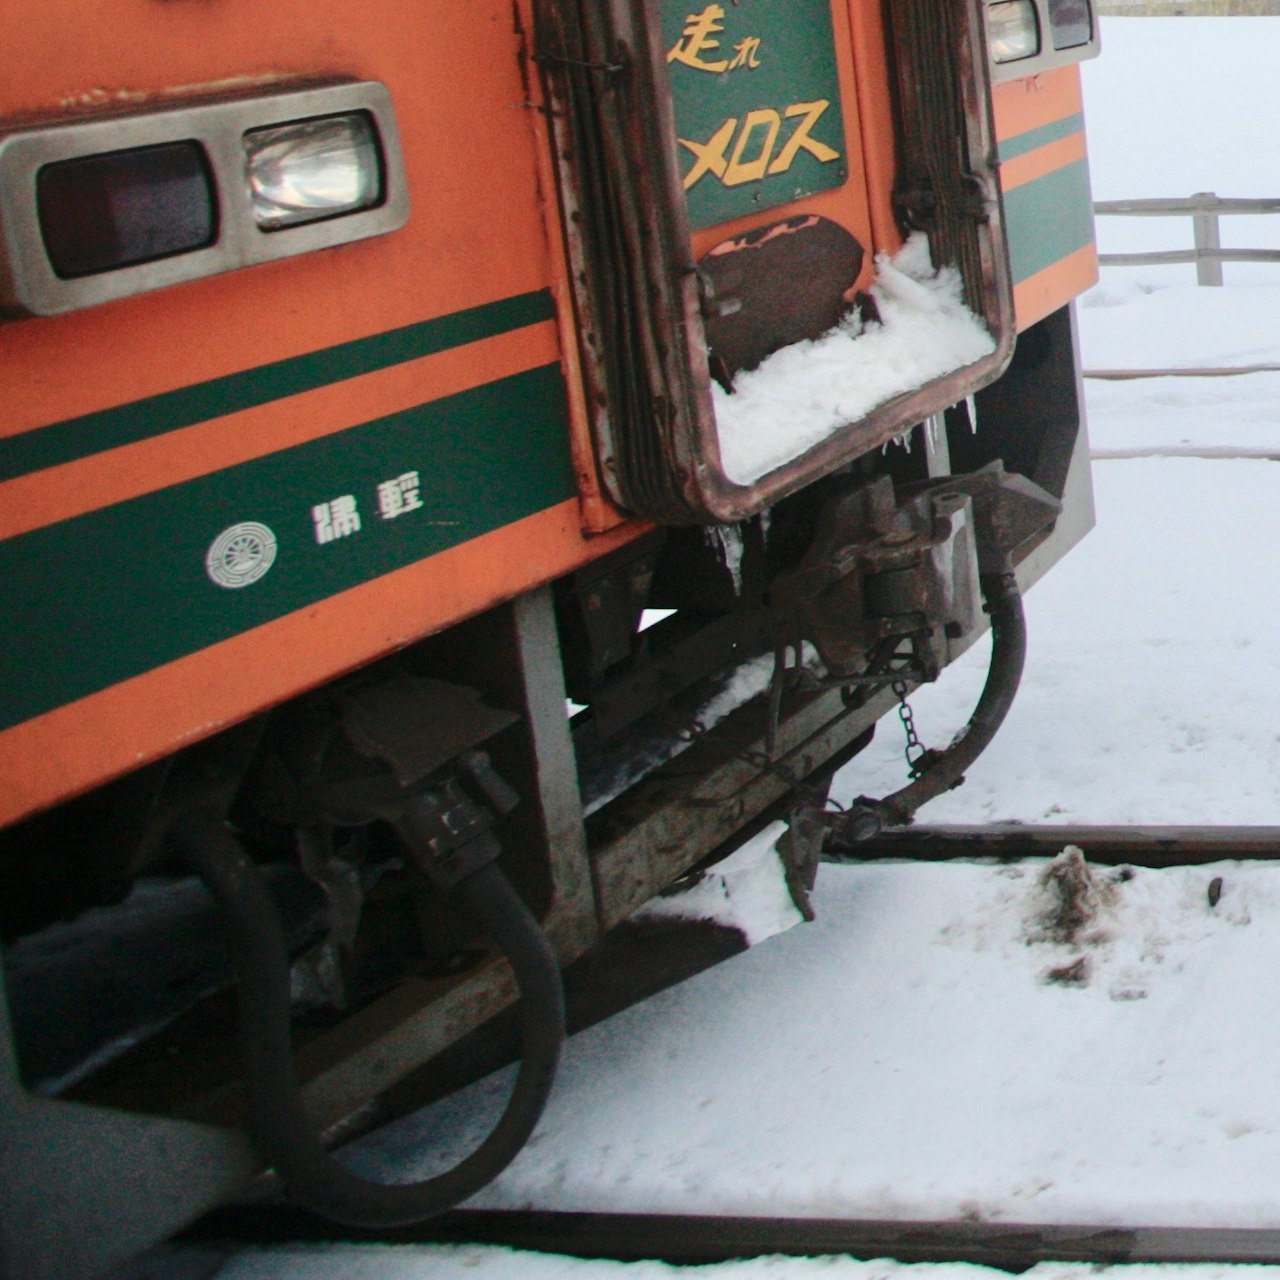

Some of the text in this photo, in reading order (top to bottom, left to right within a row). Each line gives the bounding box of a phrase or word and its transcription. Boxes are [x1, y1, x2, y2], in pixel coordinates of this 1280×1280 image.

[667, 3, 761, 73] 走れ
[677, 99, 840, 191] メロス
